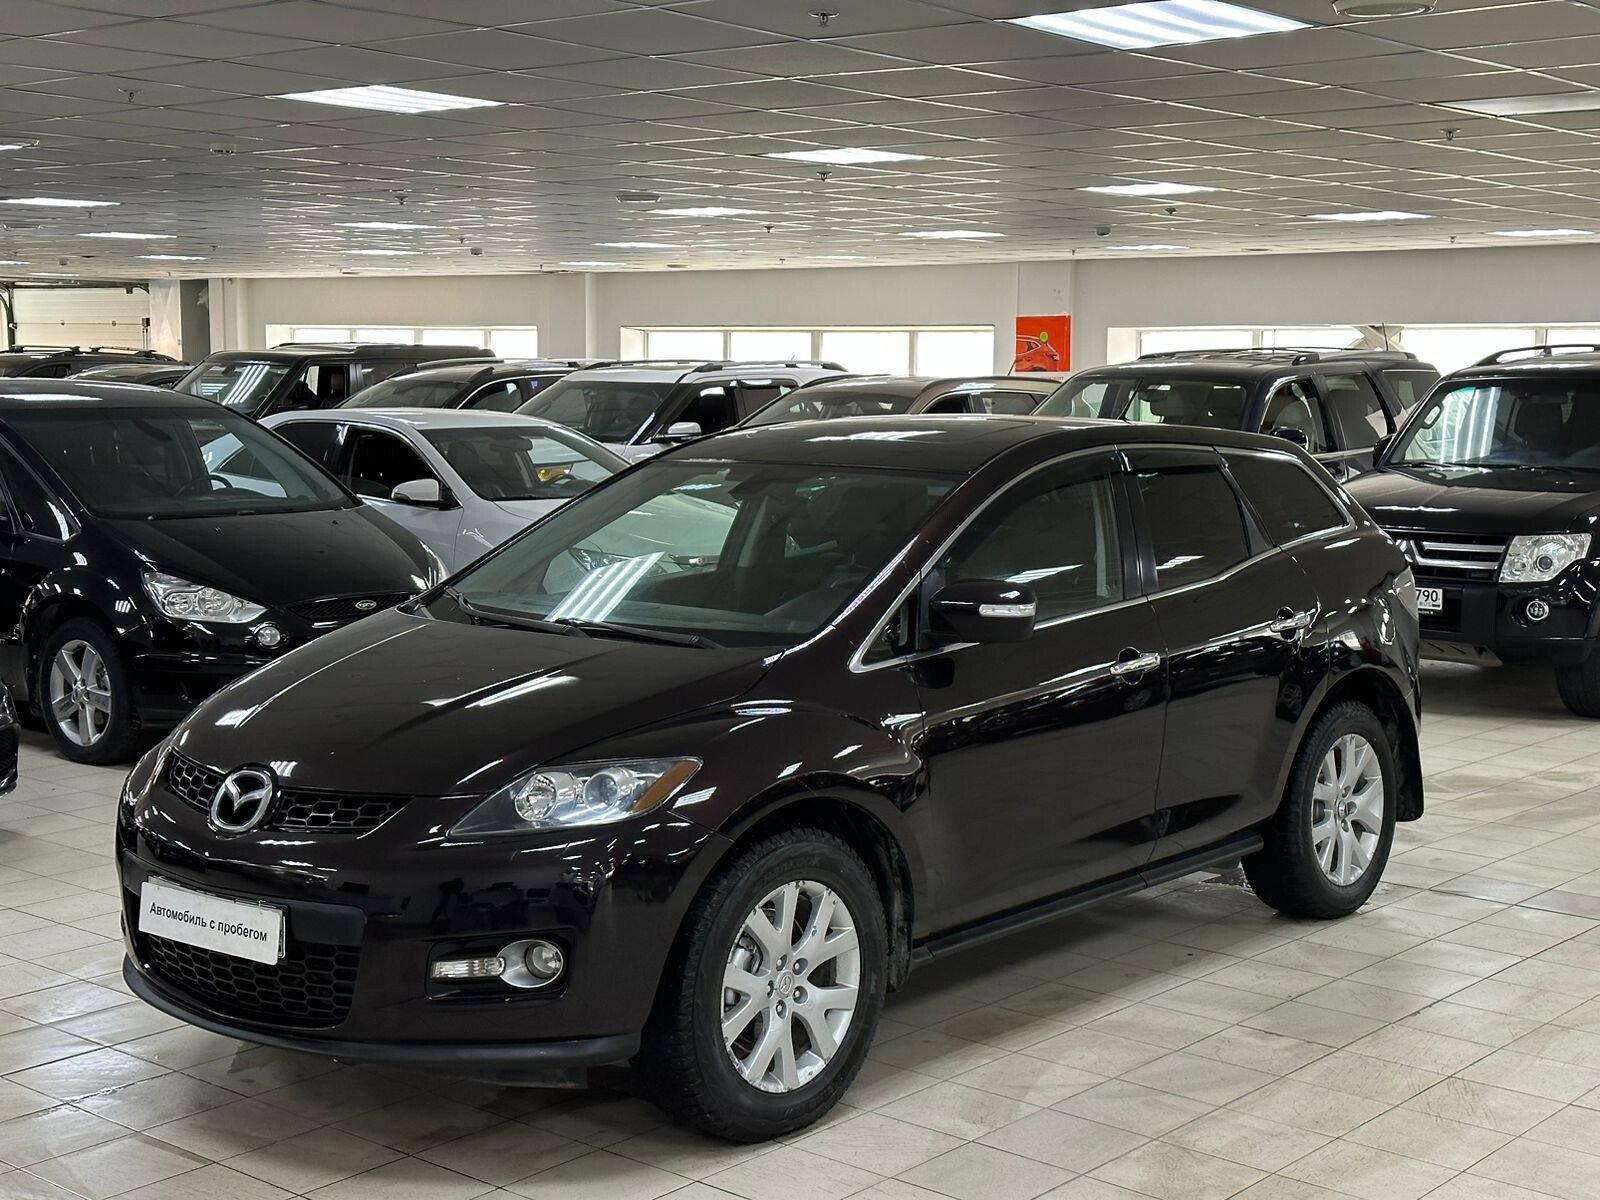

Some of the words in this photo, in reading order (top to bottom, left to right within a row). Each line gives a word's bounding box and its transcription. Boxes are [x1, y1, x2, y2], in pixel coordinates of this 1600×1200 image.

[1415, 589, 1438, 602] 790
[149, 902, 207, 927] Автомобиль
[209, 920, 215, 930] с
[217, 921, 267, 942] пробегом
